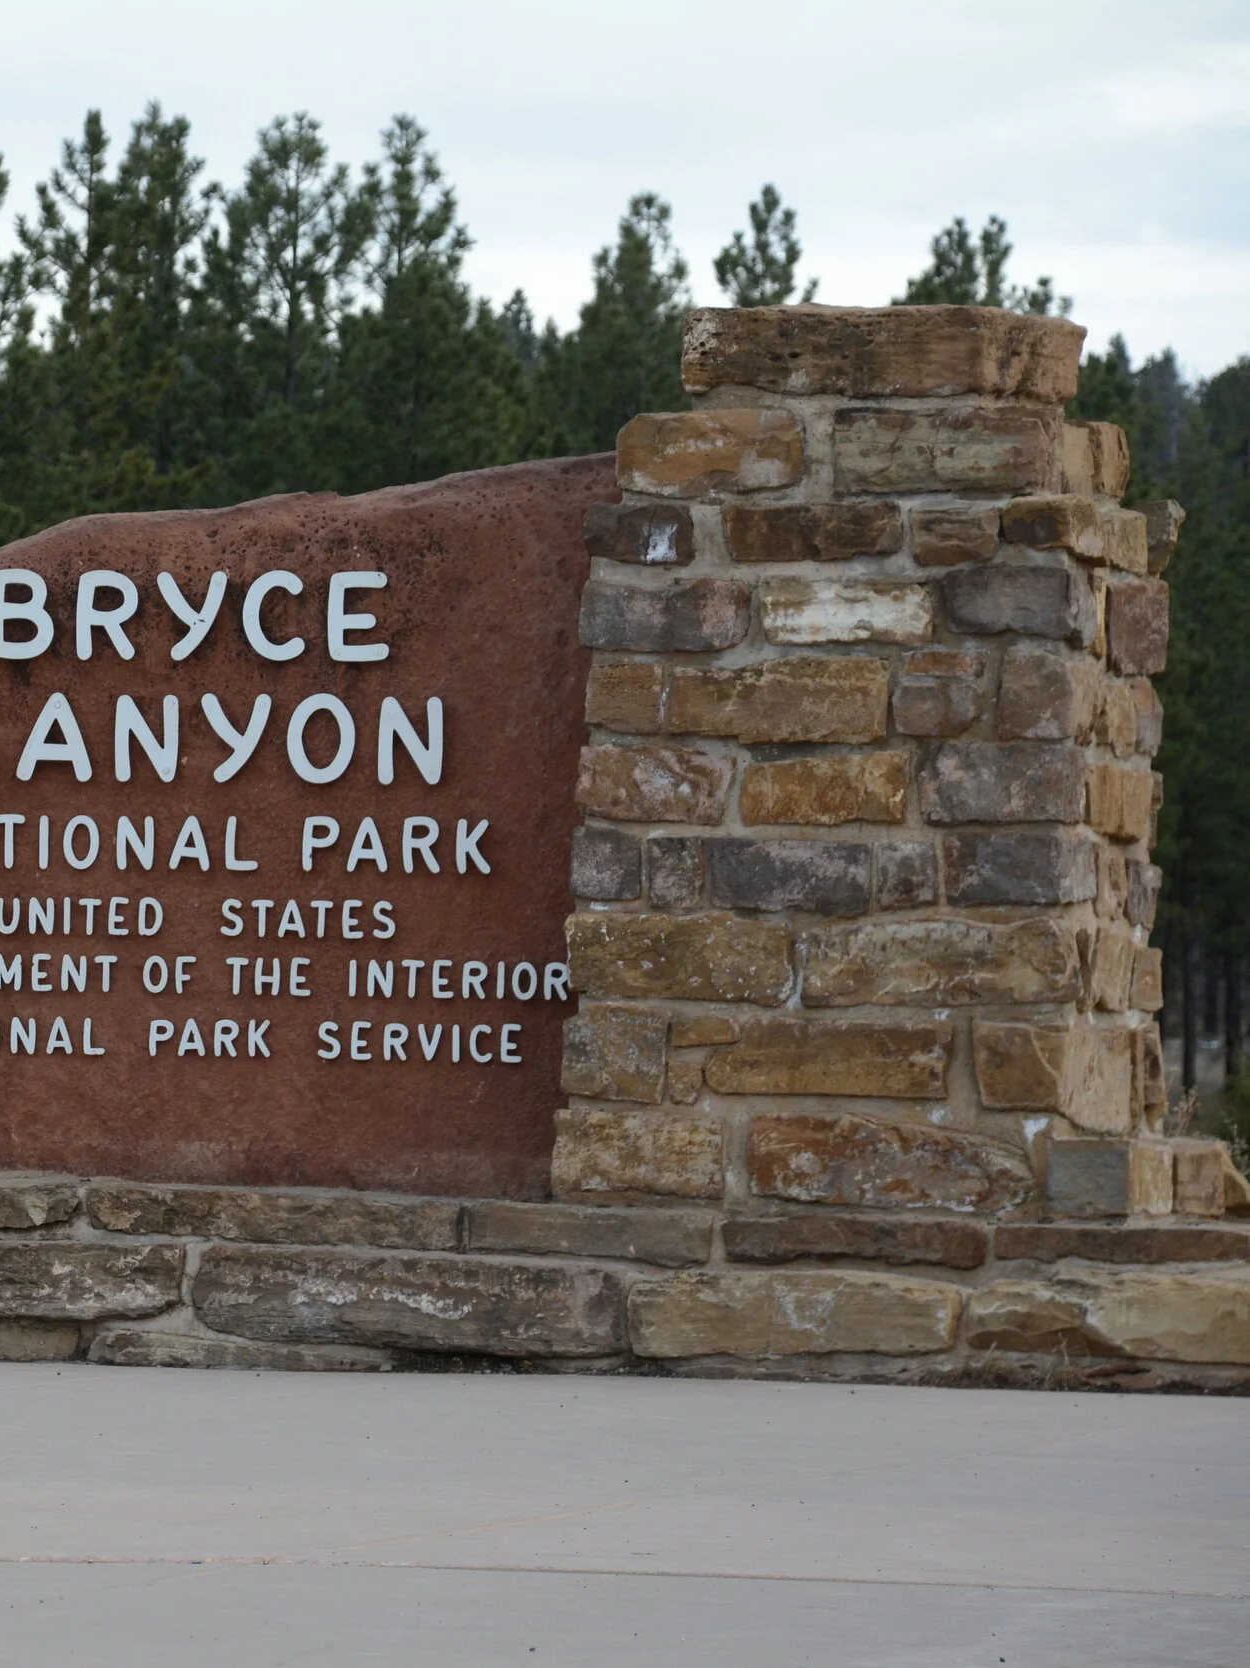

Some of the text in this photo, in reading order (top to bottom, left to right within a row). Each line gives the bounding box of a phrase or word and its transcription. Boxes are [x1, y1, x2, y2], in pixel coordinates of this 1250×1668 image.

[301, 815, 491, 874] PARK
[220, 898, 396, 939] STATES
[142, 955, 197, 994] OF
[225, 956, 311, 997] THE
[348, 959, 570, 1001] INTERIOR
[148, 1017, 271, 1058] PARK
[317, 1020, 522, 1063] SERVICE
